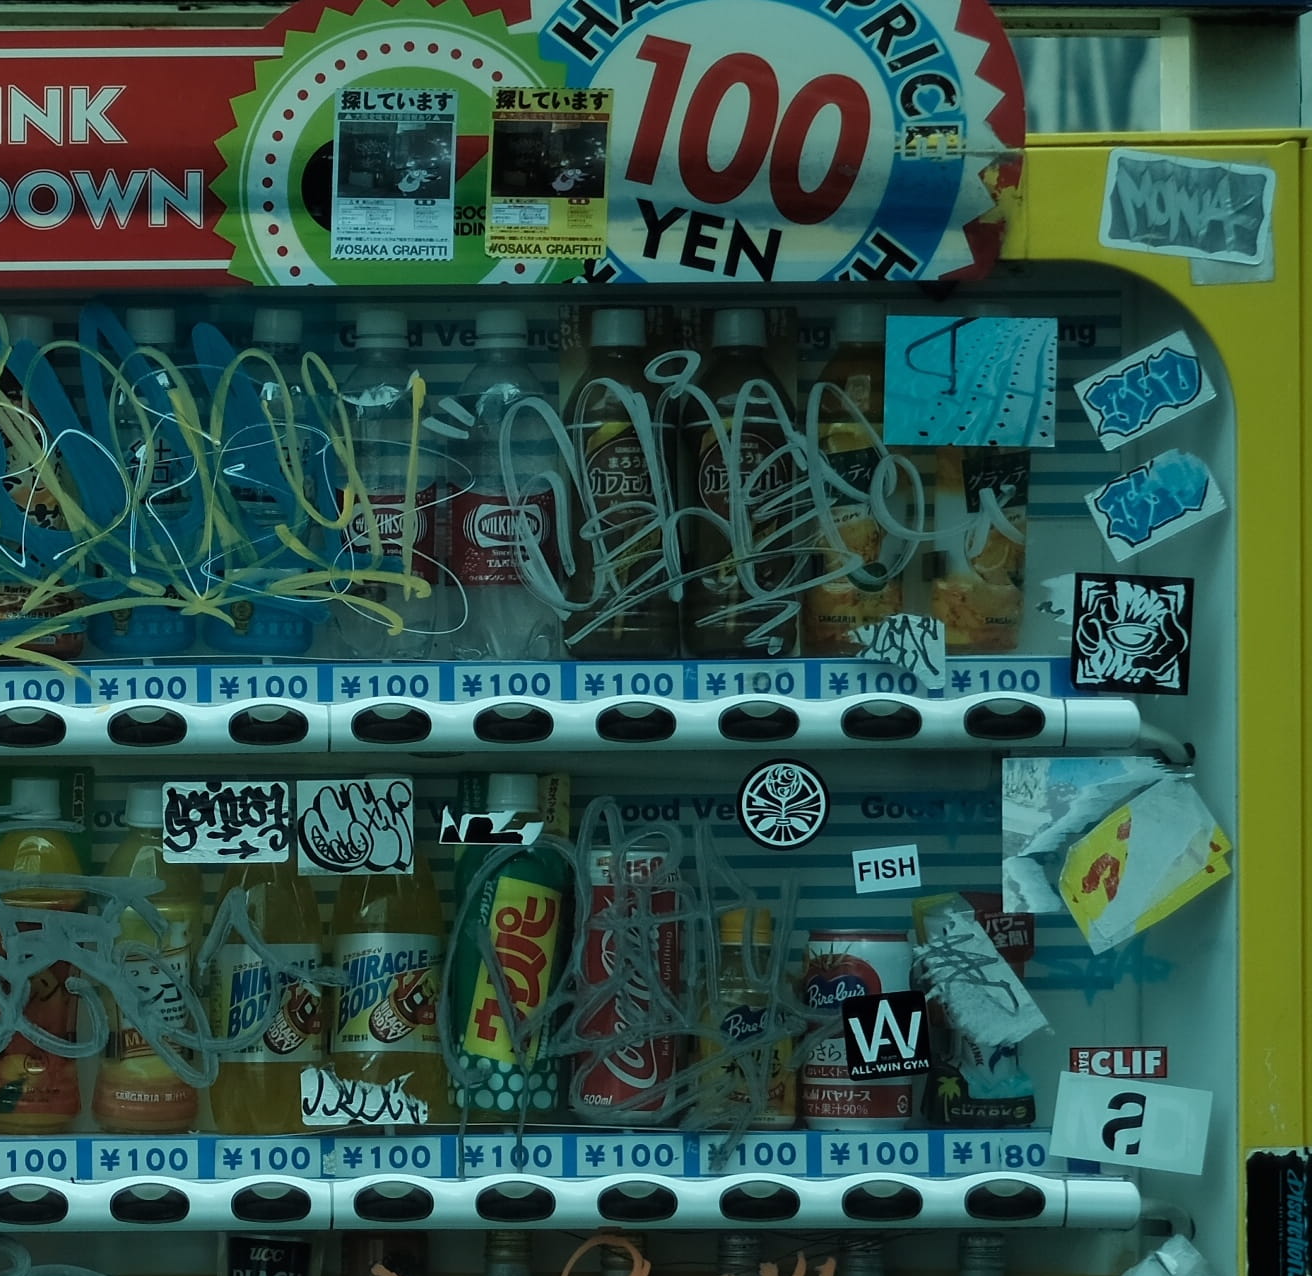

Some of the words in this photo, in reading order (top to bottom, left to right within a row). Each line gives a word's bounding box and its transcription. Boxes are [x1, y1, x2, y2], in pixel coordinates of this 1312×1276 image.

[341, 91, 453, 111] 探しています
[496, 91, 608, 111] 探しています
[627, 34, 869, 226] 100
[334, 244, 388, 256] #OSAKA
[393, 245, 447, 256] GRAFITTI
[489, 242, 542, 255] #OSAKA
[547, 243, 602, 256] GRAFITTI
[636, 199, 782, 282] YEN
[99, 676, 186, 700] ¥100
[585, 673, 673, 696] ¥100
[857, 856, 917, 882] FISH
[342, 948, 428, 988] MIRACLE
[338, 977, 396, 1035] BODY
[852, 1061, 900, 1076] ALL-WIN
[903, 1058, 929, 1070] GYM
[1091, 1050, 1162, 1076] CLIF
[101, 1148, 188, 1171] ¥100
[585, 1144, 673, 1167] ¥100
